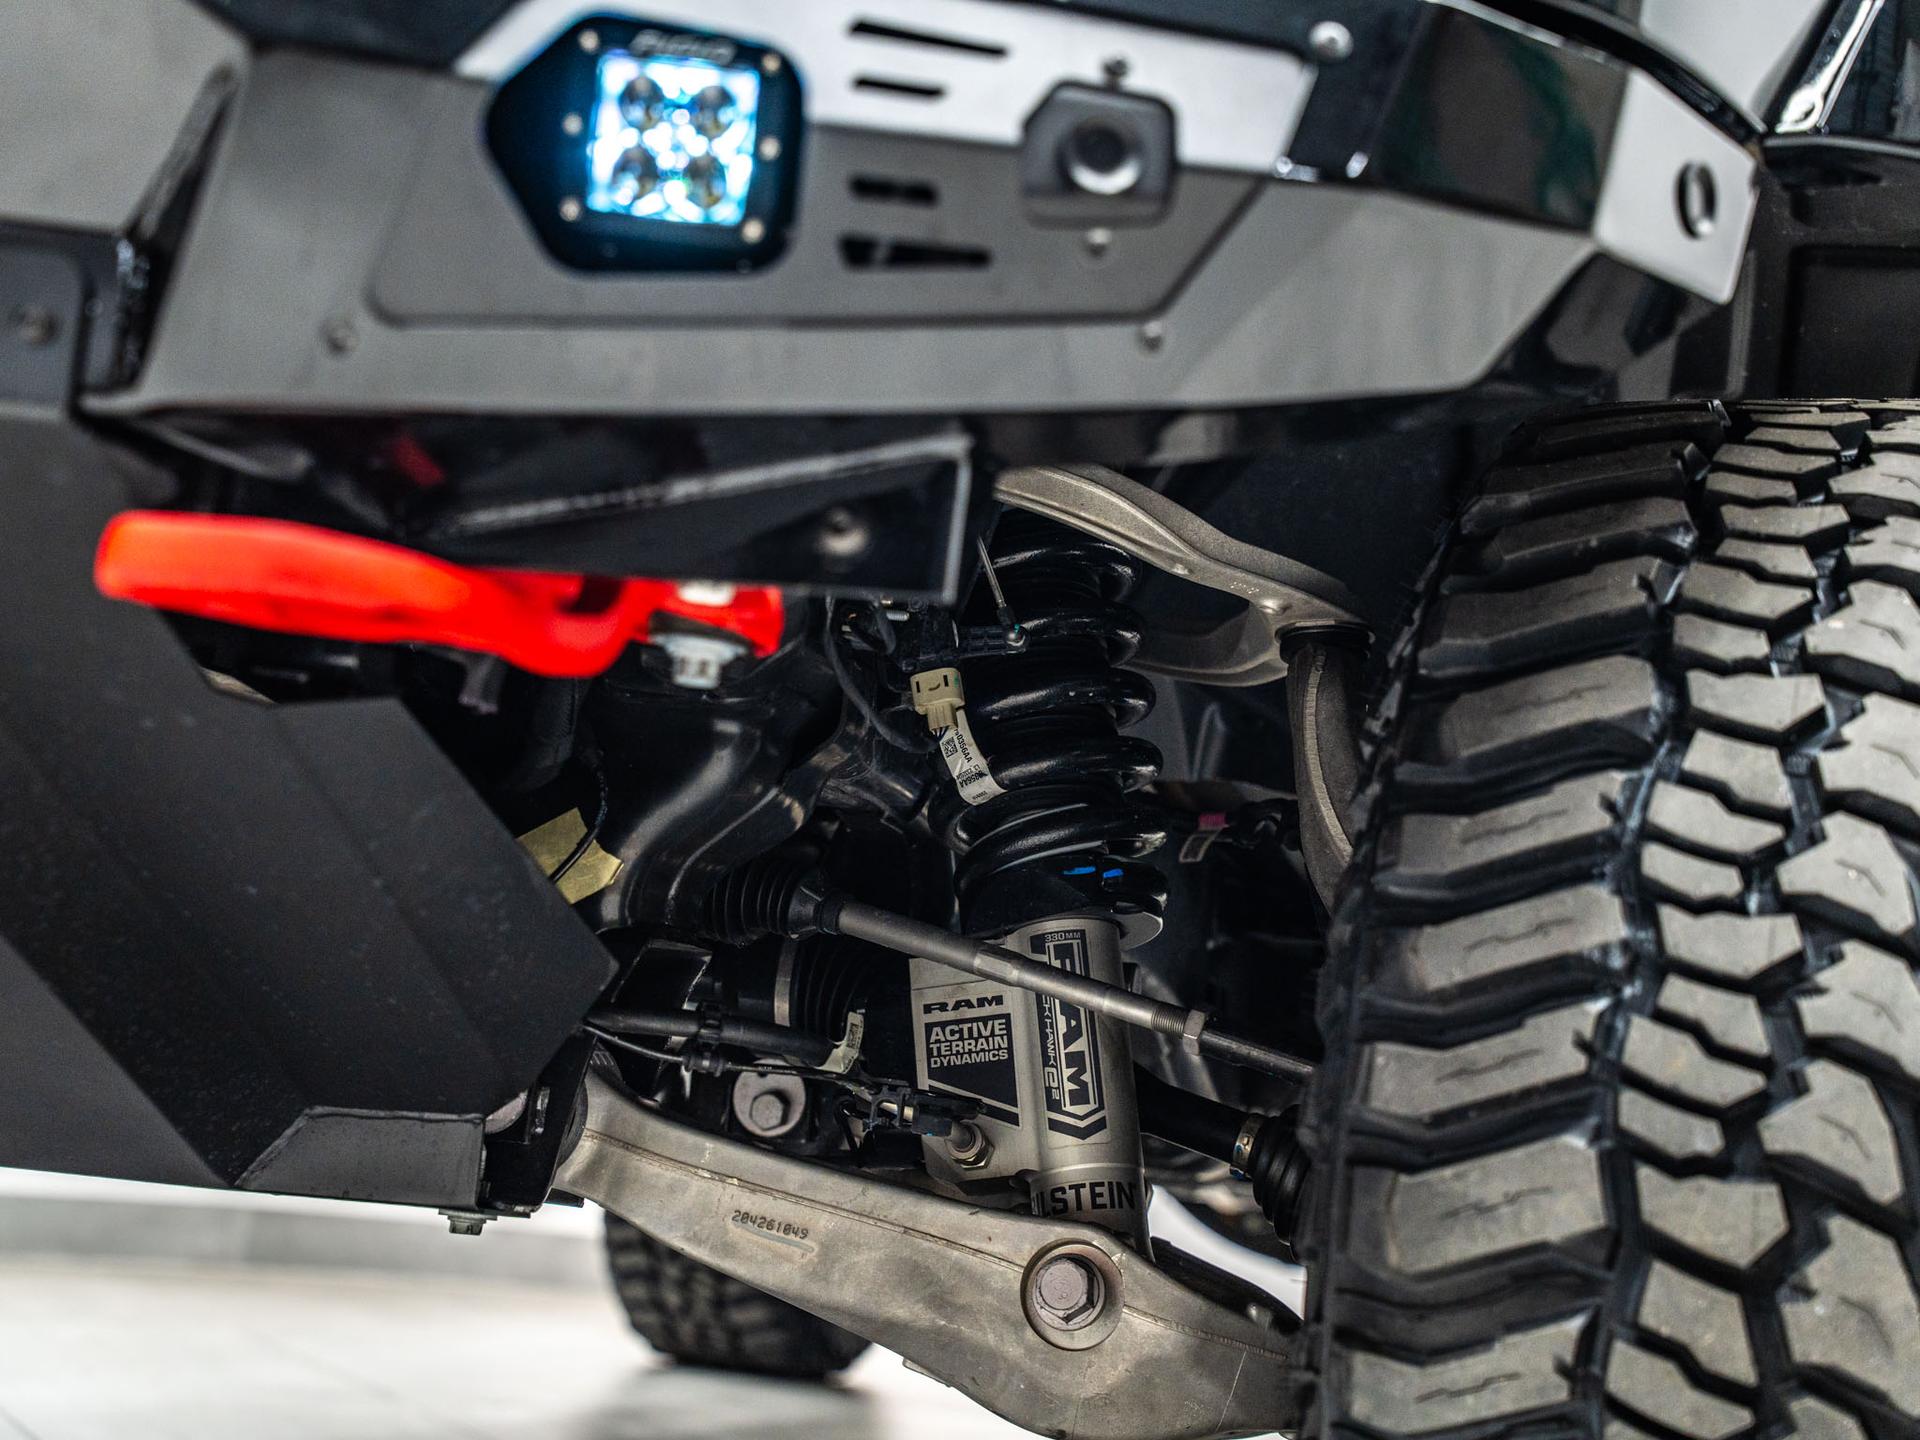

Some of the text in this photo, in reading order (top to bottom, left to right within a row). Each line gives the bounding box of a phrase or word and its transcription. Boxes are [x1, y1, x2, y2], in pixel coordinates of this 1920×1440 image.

[923, 995, 1004, 1014] RAM
[929, 1019, 1007, 1043] ACTIVE
[929, 1035, 1009, 1057] TERRAIN
[930, 1049, 1009, 1068] DYNAMICS
[1033, 1181, 1136, 1217] ILSTEIN
